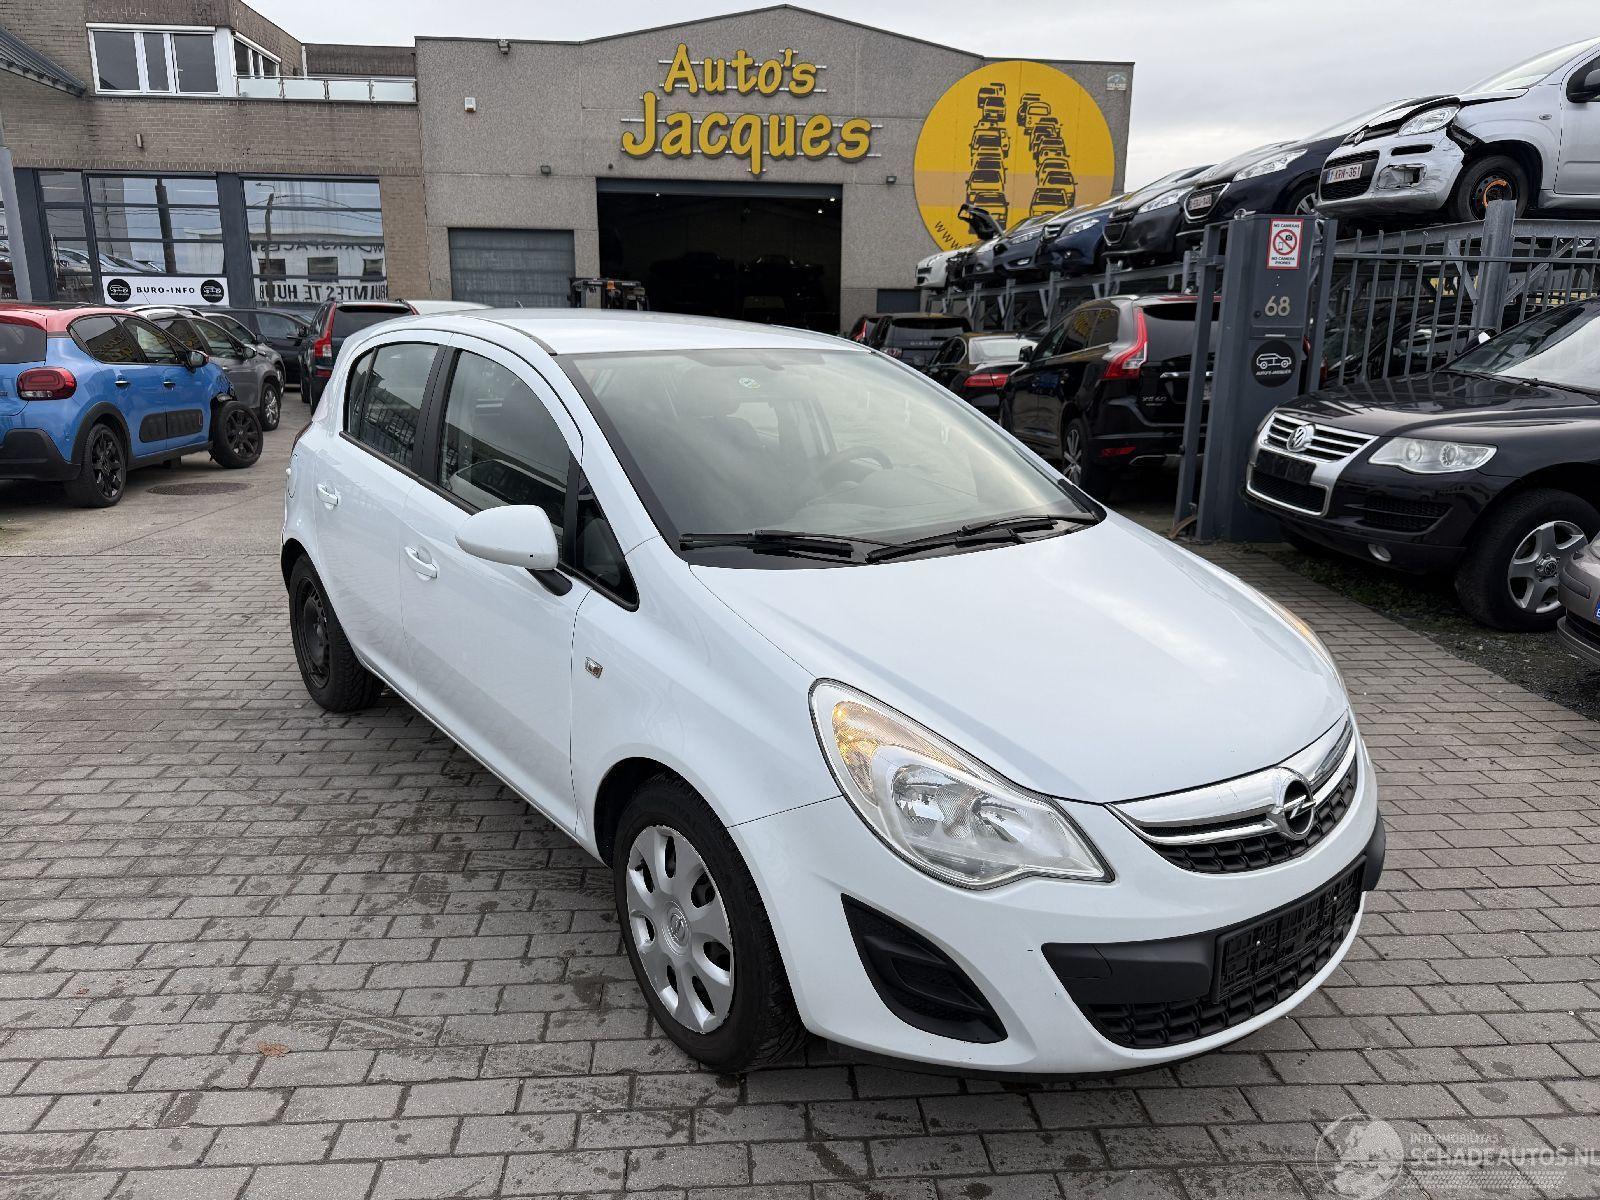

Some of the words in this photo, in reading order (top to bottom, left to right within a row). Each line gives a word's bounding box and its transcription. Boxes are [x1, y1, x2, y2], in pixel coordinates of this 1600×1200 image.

[664, 43, 817, 96] Auto's
[622, 91, 873, 175] Jacques
[1264, 296, 1290, 316] 68
